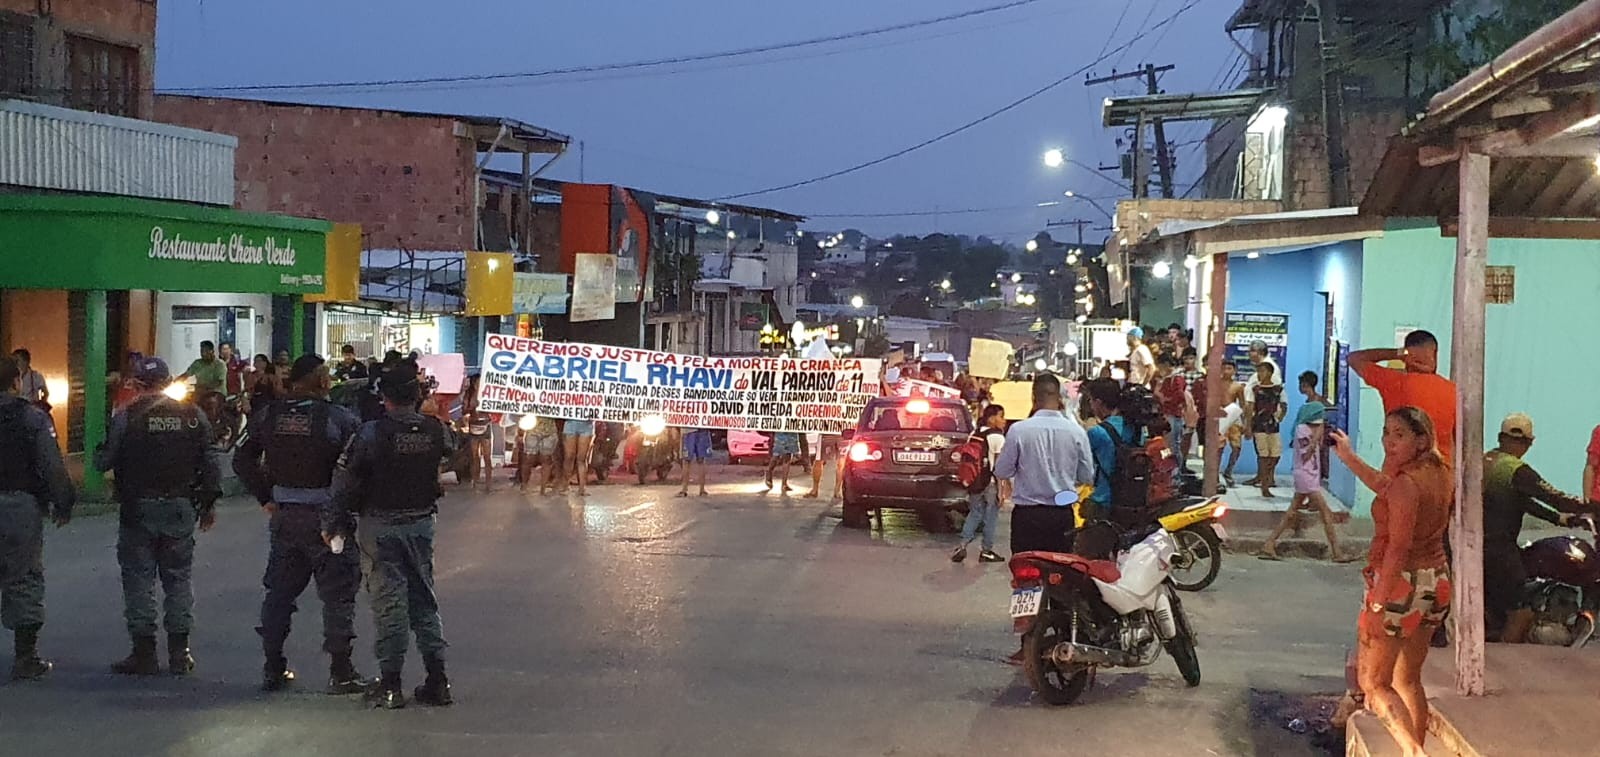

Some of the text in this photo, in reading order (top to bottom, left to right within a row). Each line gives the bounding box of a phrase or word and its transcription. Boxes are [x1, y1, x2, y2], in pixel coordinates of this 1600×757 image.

[148, 226, 296, 267] Restaurante Cheiro Verde
[489, 336, 592, 357] QUEREMOS
[682, 356, 725, 369] PELA
[728, 358, 779, 370] MORTE
[781, 359, 797, 371] DA
[485, 371, 508, 386] MAIS
[511, 375, 533, 389] UMA
[568, 380, 581, 392] DE
[581, 380, 606, 394] BALA
[609, 382, 648, 397] PERDIDA
[650, 386, 681, 399] DESSES
[728, 390, 745, 401] QUE
[759, 391, 778, 402] VEM
[780, 391, 816, 403] TIRANDO
[818, 392, 838, 404] VIDA
[491, 351, 637, 384] GABRIEL
[646, 363, 733, 390] RHAVI
[734, 372, 749, 390] do
[751, 370, 778, 391] VAL
[835, 373, 850, 393] de
[850, 372, 864, 393] 11
[481, 400, 521, 414] ESTAMOS
[522, 403, 561, 416] CANSADOS
[562, 407, 575, 418] DE
[575, 407, 601, 420] FICAR
[701, 414, 746, 429] CRIMINOSOS
[746, 416, 760, 429] QUE
[538, 390, 604, 407] GOVERNADOR
[604, 394, 636, 410] WILSON
[637, 398, 661, 412] LIMA
[662, 399, 709, 414] PREFEITO
[711, 400, 745, 416] DAVID
[747, 402, 793, 417] ALMEIDA
[795, 403, 842, 419] QUEREMOS
[842, 406, 865, 420] JUST
